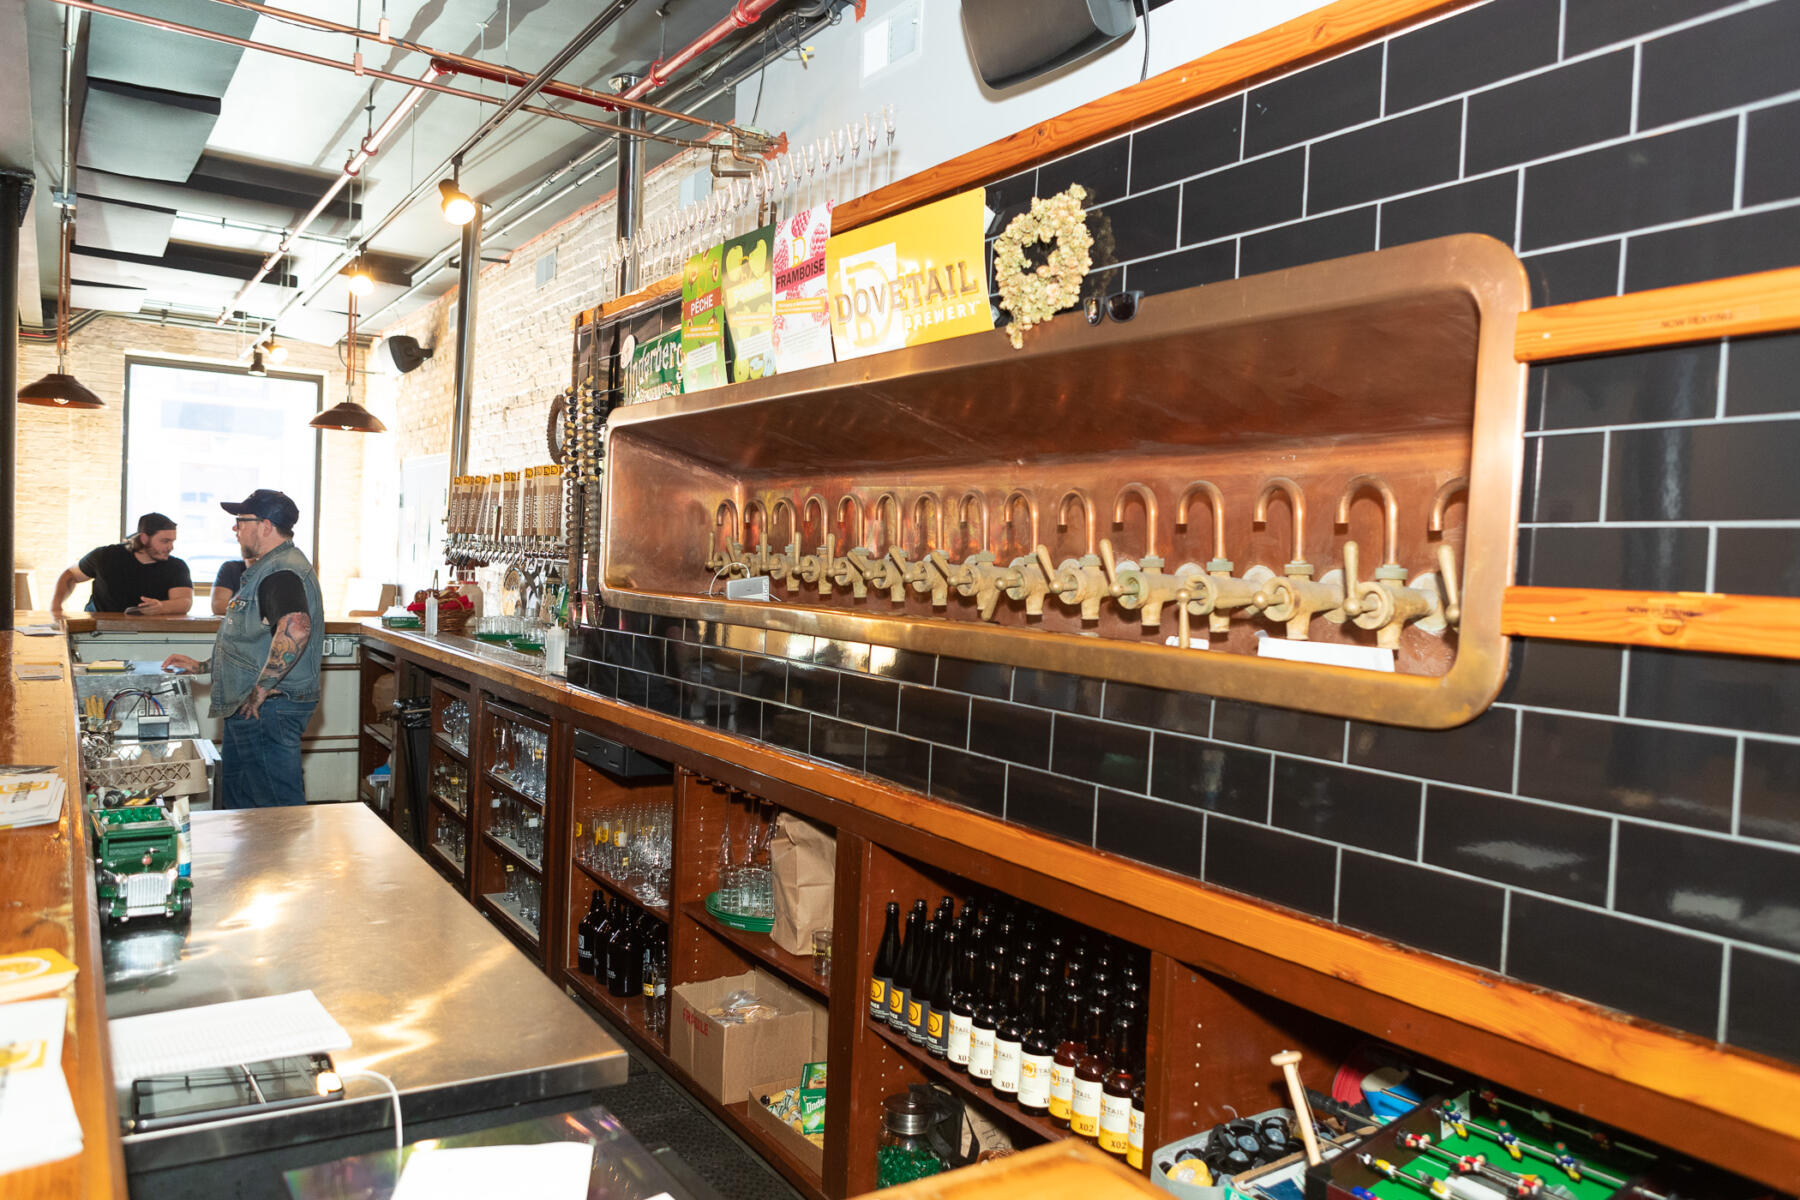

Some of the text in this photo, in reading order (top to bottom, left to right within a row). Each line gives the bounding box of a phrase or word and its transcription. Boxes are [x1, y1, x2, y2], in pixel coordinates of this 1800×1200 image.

[776, 257, 825, 291] FRAMBOISE
[690, 293, 714, 318] PÊCHE
[835, 261, 979, 324] DOVETAIL
